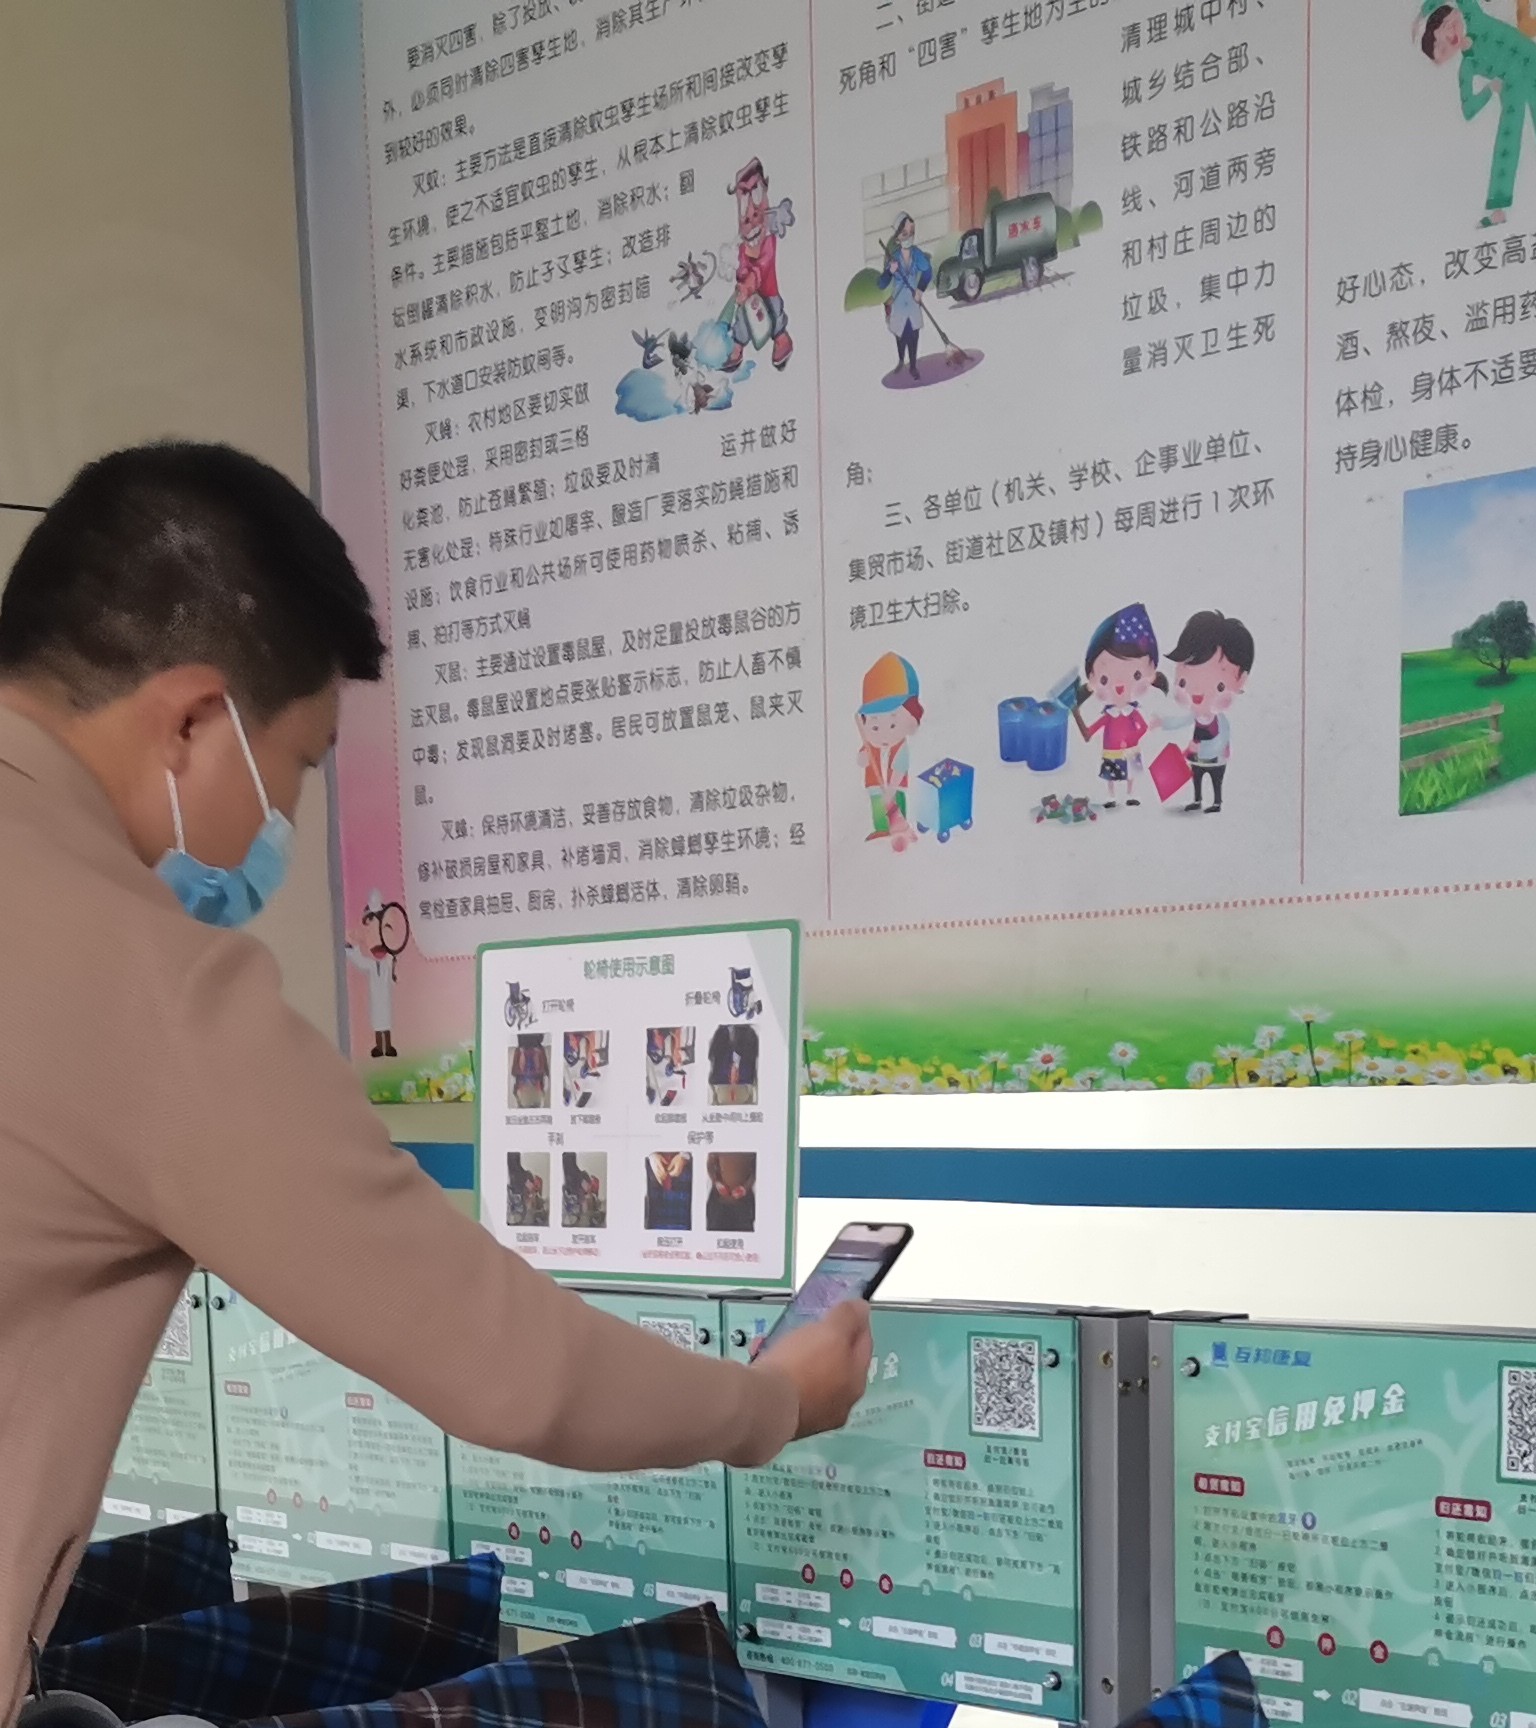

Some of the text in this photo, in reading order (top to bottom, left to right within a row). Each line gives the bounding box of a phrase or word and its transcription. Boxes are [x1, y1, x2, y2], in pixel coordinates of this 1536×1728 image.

[1121, 41, 1265, 108] 城乡结合部、
[1120, 90, 1277, 162] 铁路和公路沿
[1120, 145, 1277, 216] 线、河道两旁
[1121, 203, 1277, 269] 和村庄周边的
[1121, 313, 1277, 377] 量消灭卫生死
[1334, 422, 1472, 474] 持身心健康。
[1203, 1381, 1408, 1449] 支付宝信用免押金
